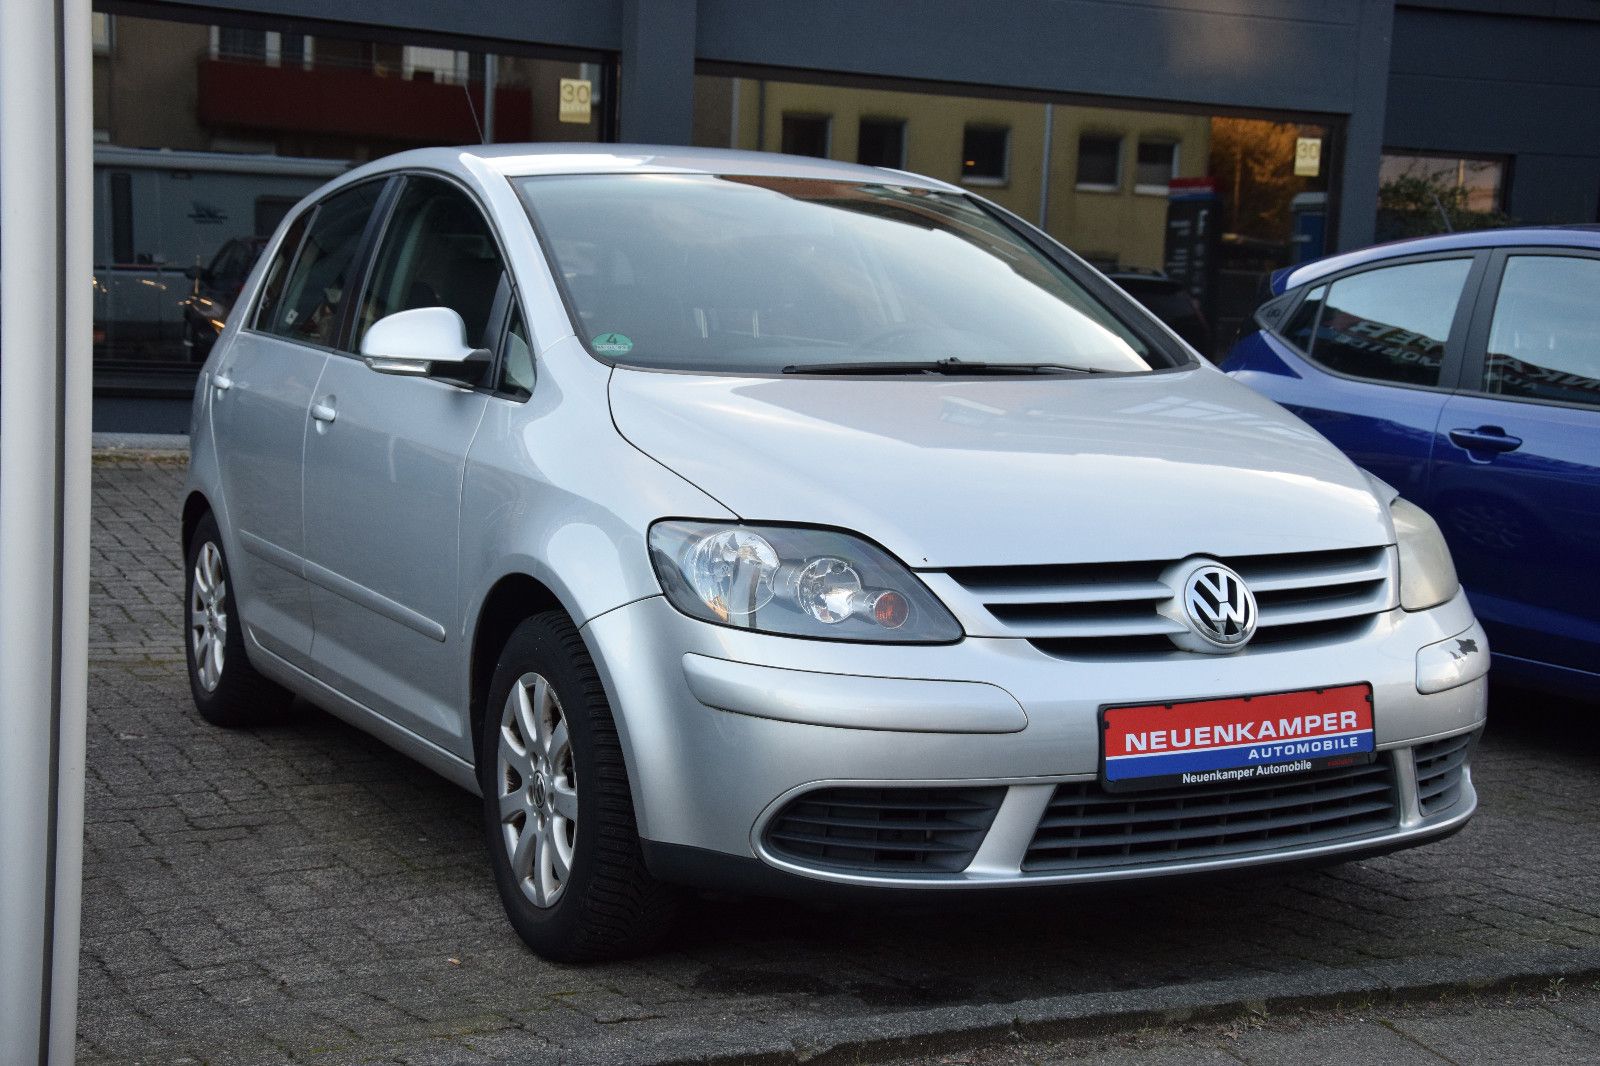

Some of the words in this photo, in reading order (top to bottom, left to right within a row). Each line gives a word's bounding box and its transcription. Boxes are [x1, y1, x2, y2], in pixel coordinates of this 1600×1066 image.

[562, 84, 589, 104] 30
[1125, 710, 1358, 752] NEUENKAMPER
[1248, 736, 1358, 760] AUTOMOBILE
[1182, 767, 1254, 784] Neuenkamper
[1256, 760, 1312, 776] Automobile
